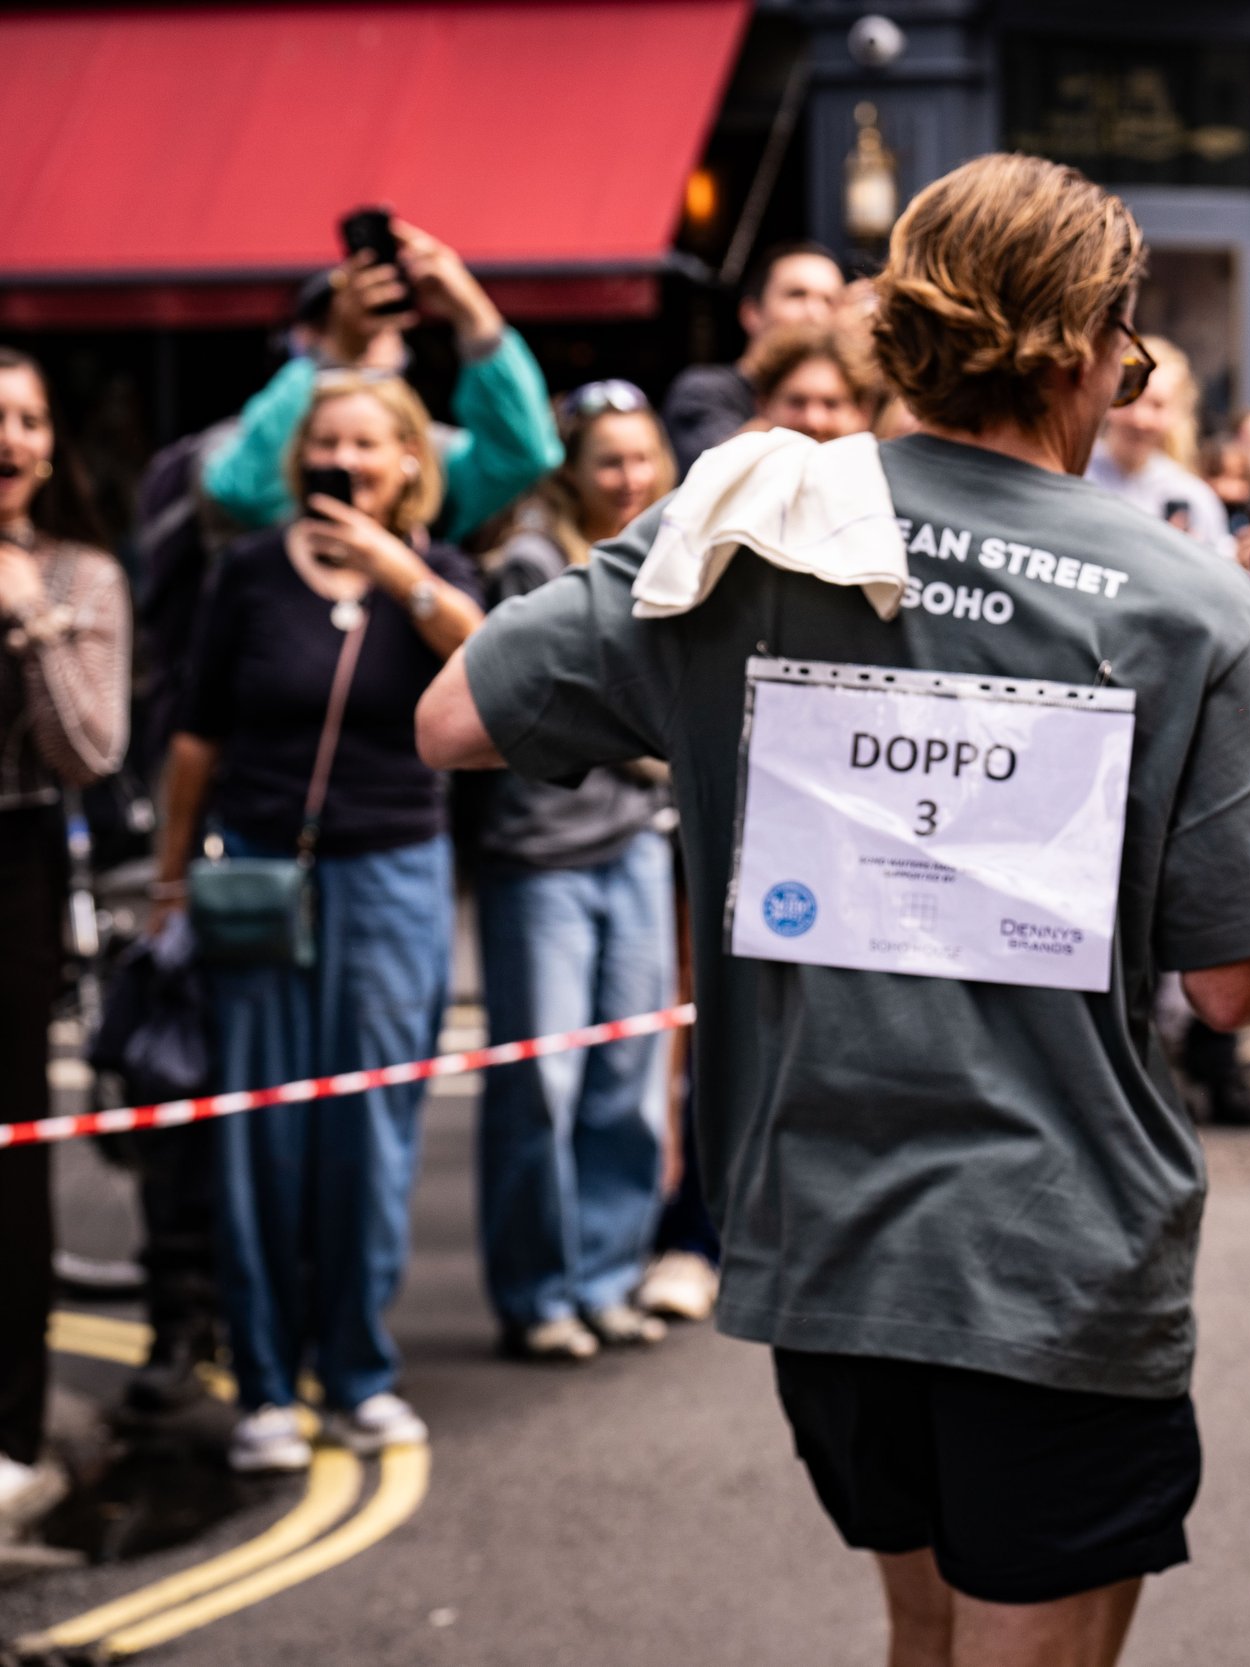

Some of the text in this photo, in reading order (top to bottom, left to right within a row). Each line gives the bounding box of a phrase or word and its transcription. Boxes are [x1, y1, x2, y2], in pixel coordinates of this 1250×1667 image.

[896, 518, 1129, 599] EAN STREET
[900, 576, 1015, 625] SOHO
[850, 732, 1018, 781] DOPPO
[914, 799, 939, 837] 3
[1000, 918, 1084, 943] DENNYS
[1007, 938, 1074, 956] BRANDS
